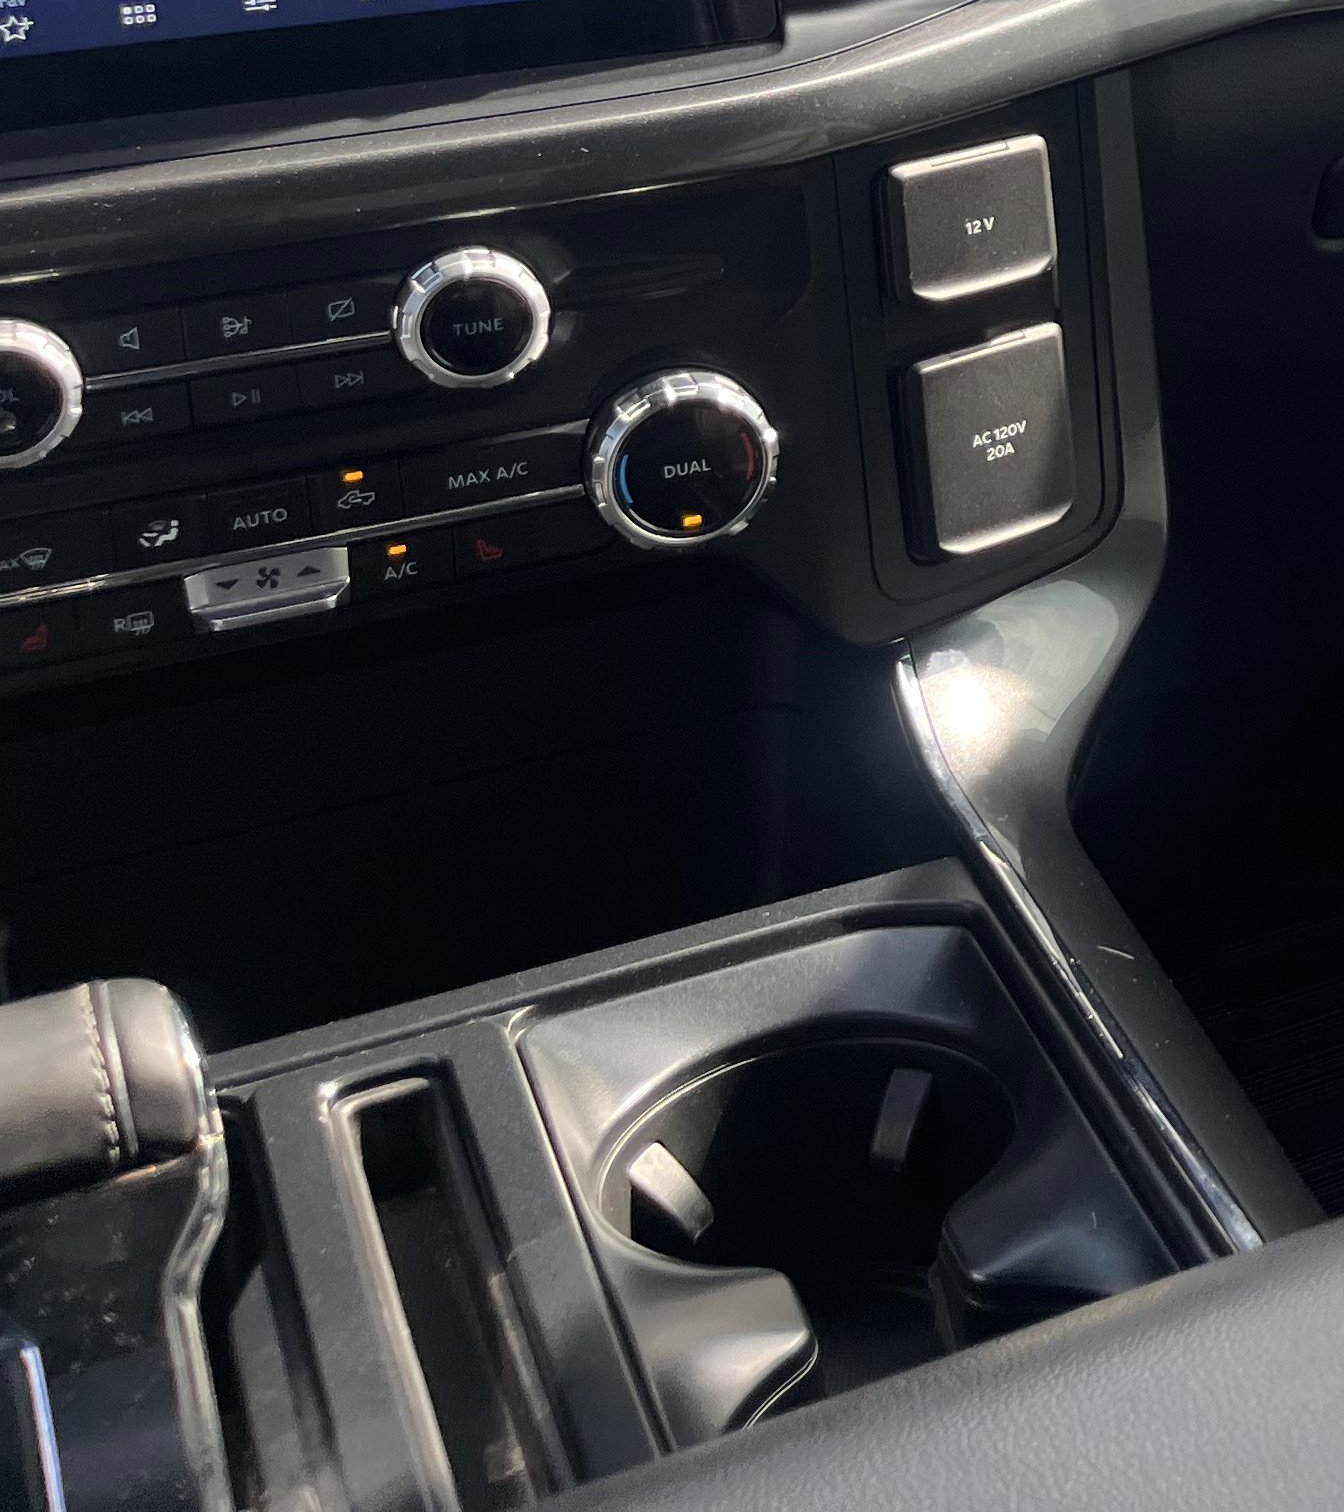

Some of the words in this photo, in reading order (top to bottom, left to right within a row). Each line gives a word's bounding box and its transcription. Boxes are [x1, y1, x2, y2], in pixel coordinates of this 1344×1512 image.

[452, 319, 504, 336] TUNE
[973, 433, 994, 449] AC
[993, 420, 1027, 442] 120V
[986, 444, 1015, 462] 20A
[448, 470, 491, 490] MAX
[493, 461, 529, 480] A/C
[663, 459, 711, 478] DUAL
[233, 508, 288, 530] AUTO
[385, 561, 418, 579] A/C
